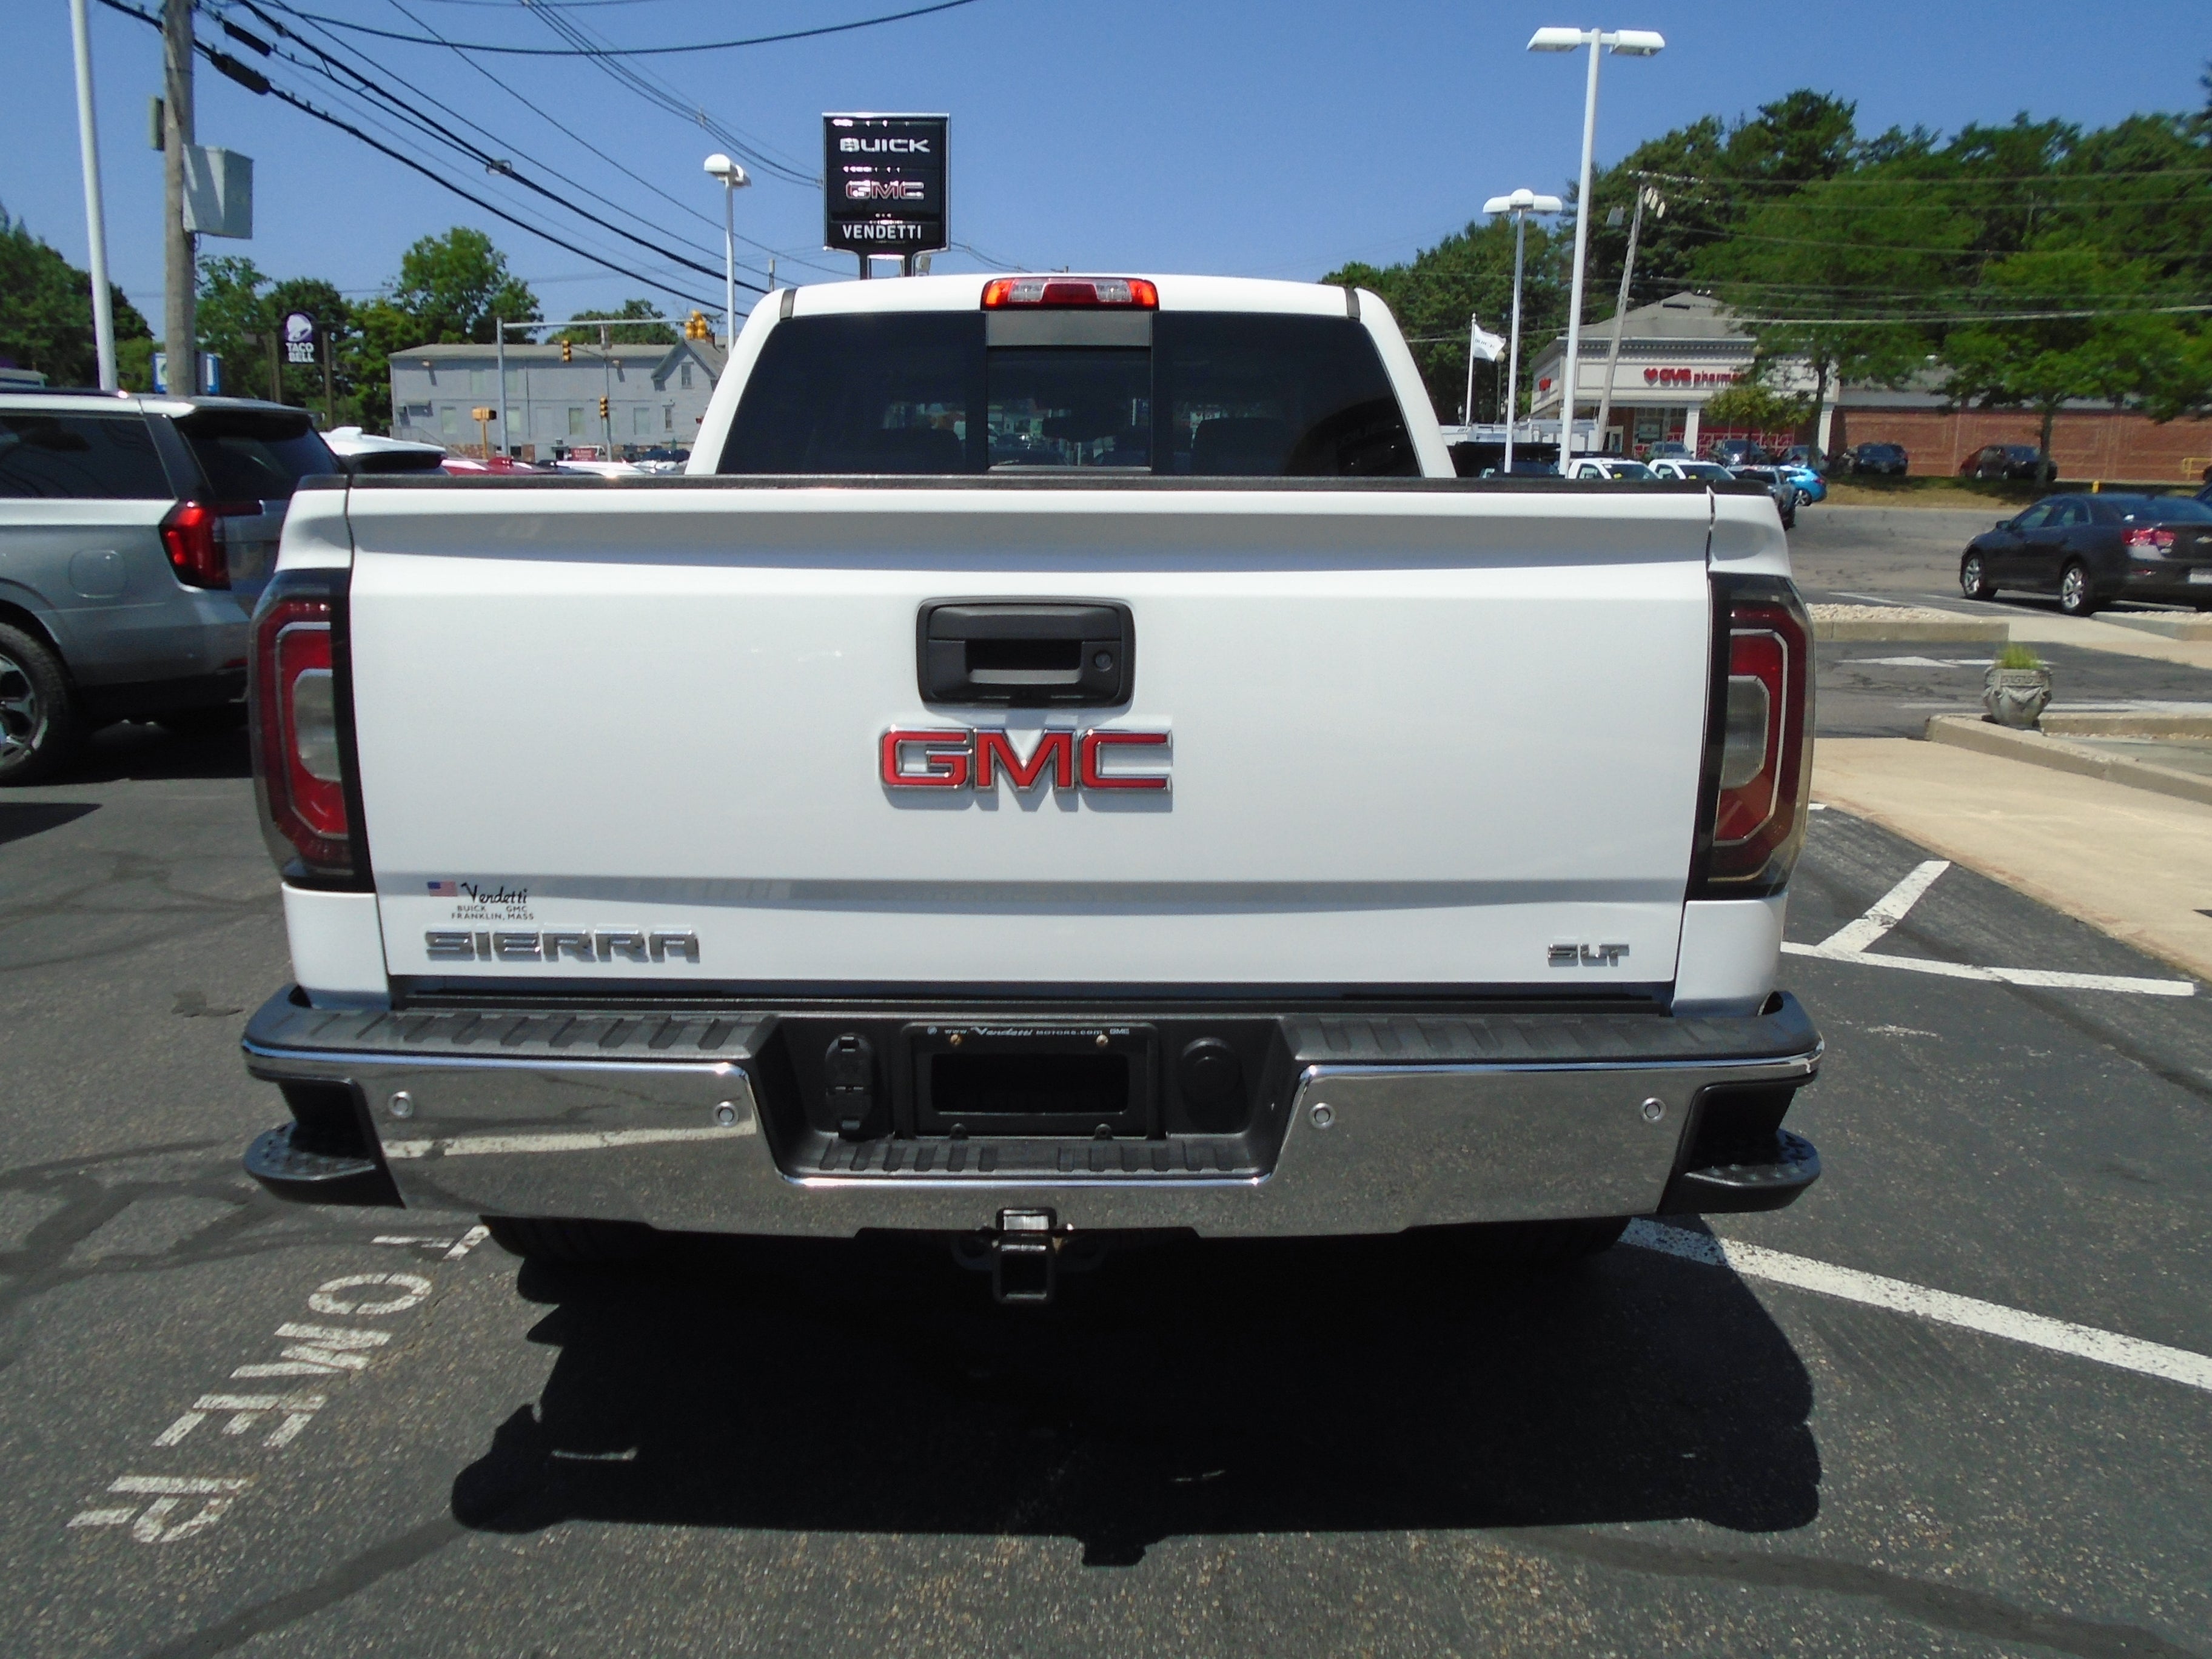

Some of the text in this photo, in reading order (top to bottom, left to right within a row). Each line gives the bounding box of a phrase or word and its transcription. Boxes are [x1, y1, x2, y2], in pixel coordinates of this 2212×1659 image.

[840, 138, 930, 152] BUICK
[846, 180, 924, 199] GMC
[842, 224, 922, 239] VENDETTI
[286, 342, 314, 352] TACO
[289, 352, 315, 363] BELL
[1659, 368, 1692, 383] CVS
[879, 728, 1173, 790] GMC
[461, 882, 528, 904] Vendetti
[424, 928, 700, 961] SIERRA
[1547, 943, 1630, 962] SLT
[65, 1224, 490, 1543] TOMER
